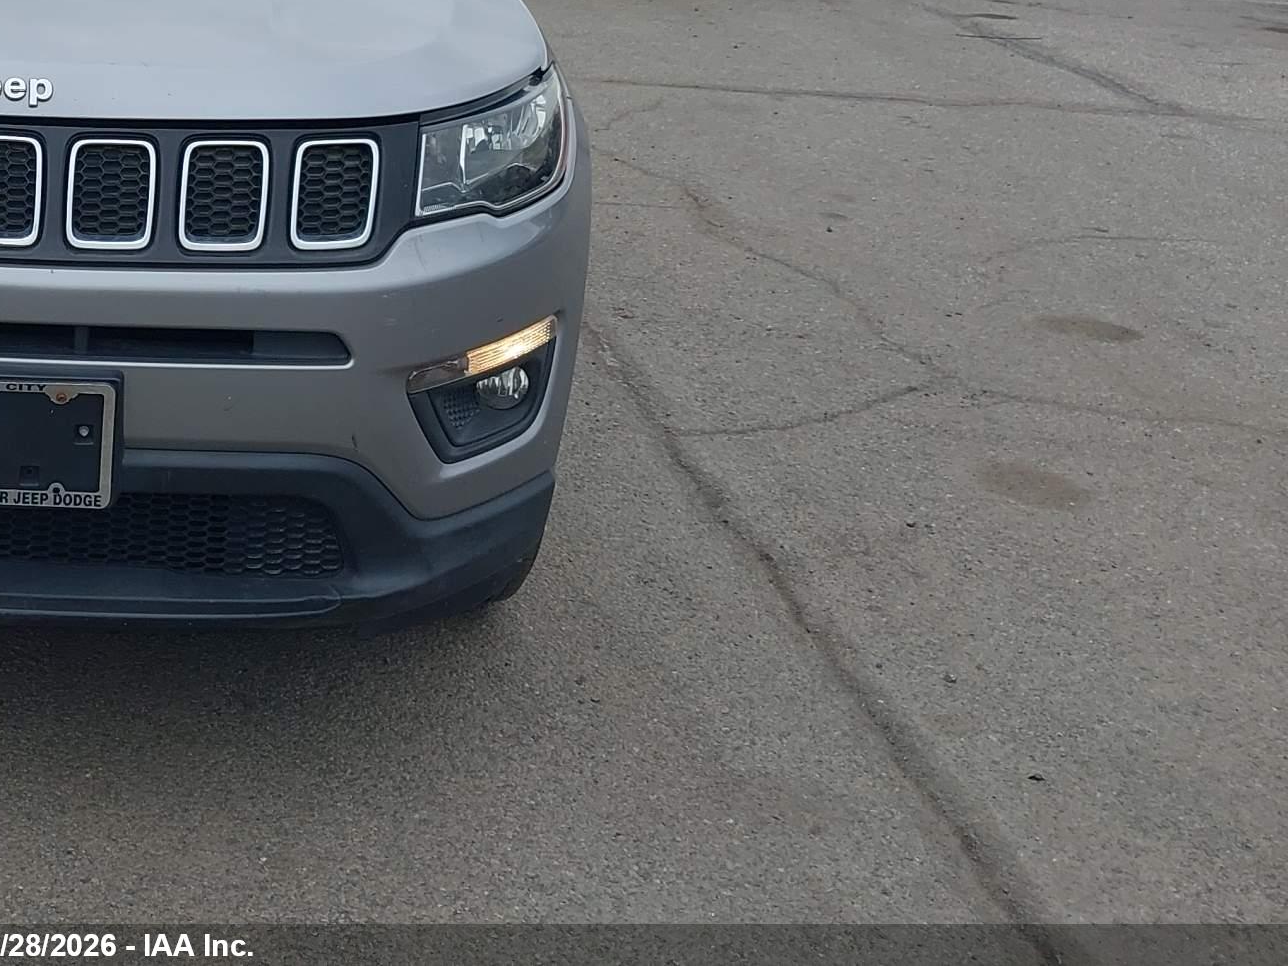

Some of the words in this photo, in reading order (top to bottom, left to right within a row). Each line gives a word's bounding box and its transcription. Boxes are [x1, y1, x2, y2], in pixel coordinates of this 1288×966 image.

[6, 383, 47, 392] CITY
[13, 491, 49, 505] JEEP
[54, 493, 102, 507] DODGE
